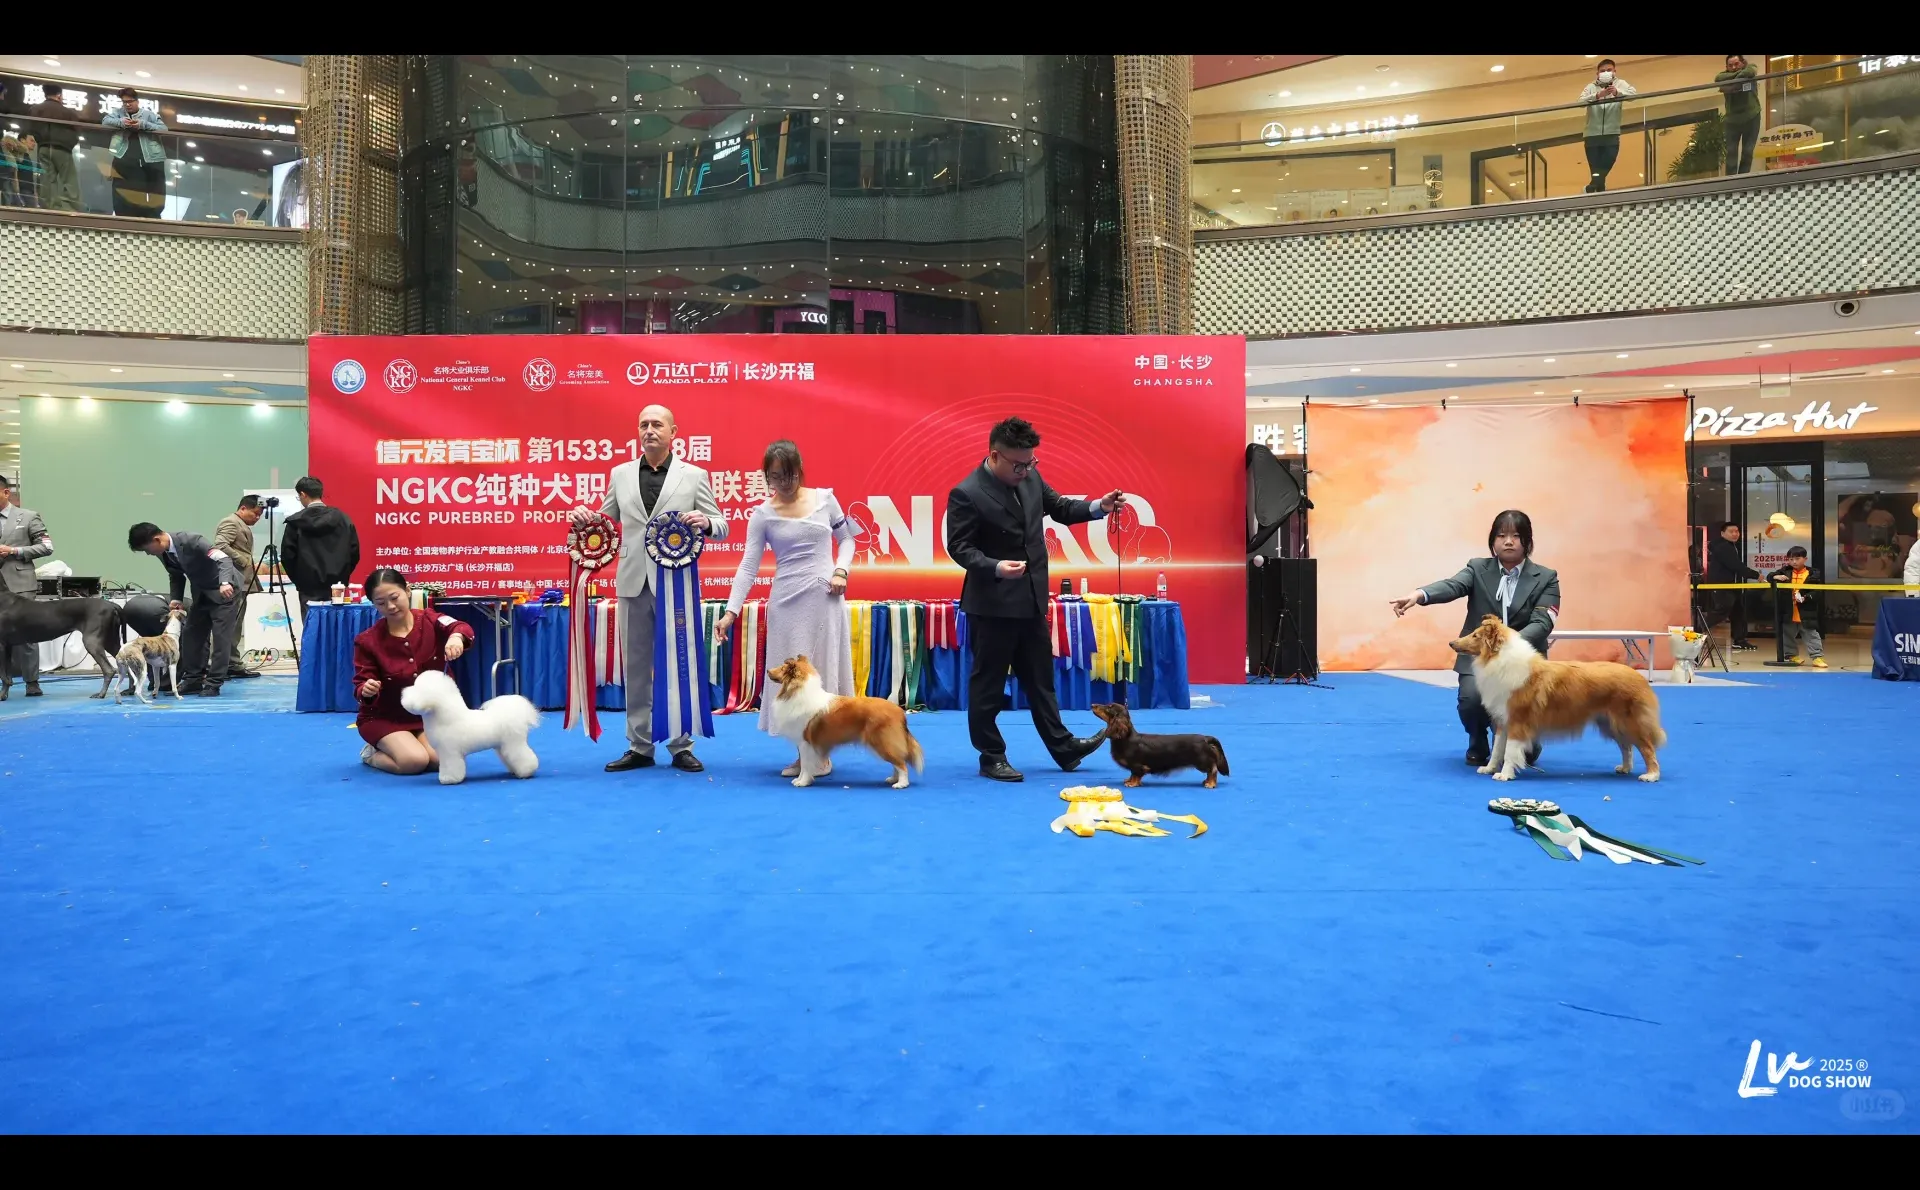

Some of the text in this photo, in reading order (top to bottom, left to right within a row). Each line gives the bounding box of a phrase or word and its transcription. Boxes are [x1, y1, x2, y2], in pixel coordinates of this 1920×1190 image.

[1134, 354, 1213, 370] 中国·长沙
[433, 366, 490, 375] 名将犬业俱乐部
[567, 369, 604, 379] 名将宠美
[652, 361, 729, 378] 万达广场
[742, 362, 815, 381] 长沙开福
[420, 376, 445, 384] National
[1133, 378, 1213, 386] CHANGSHA
[452, 384, 474, 392] NGKC
[1684, 400, 1879, 442] Pizza Hut
[376, 436, 712, 464] 信元发育宝杯 第1533-18届
[375, 511, 421, 525] NGKC
[428, 510, 515, 525] PUREBRED
[722, 507, 755, 521] EAG
[415, 563, 464, 572] 长沙万达广场
